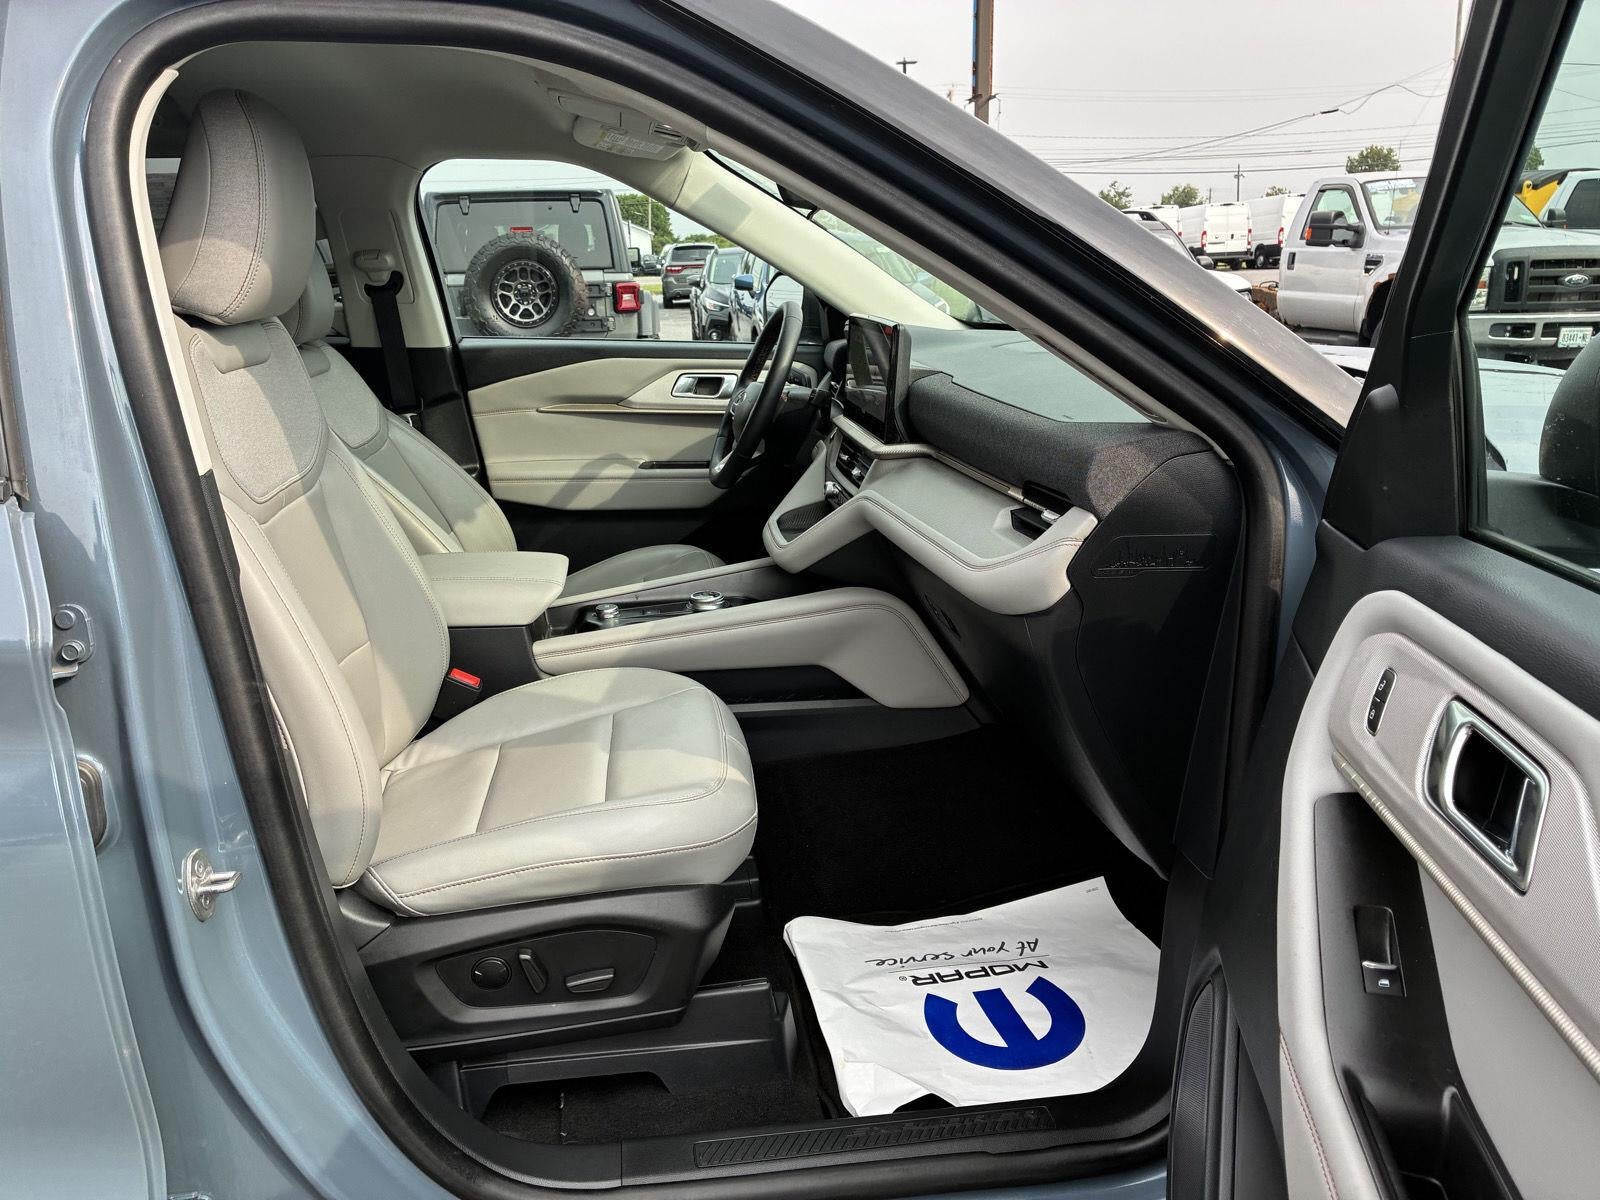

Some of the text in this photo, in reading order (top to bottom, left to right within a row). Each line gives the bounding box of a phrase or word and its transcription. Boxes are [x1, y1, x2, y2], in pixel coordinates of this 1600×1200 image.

[864, 938, 1039, 968] At your service
